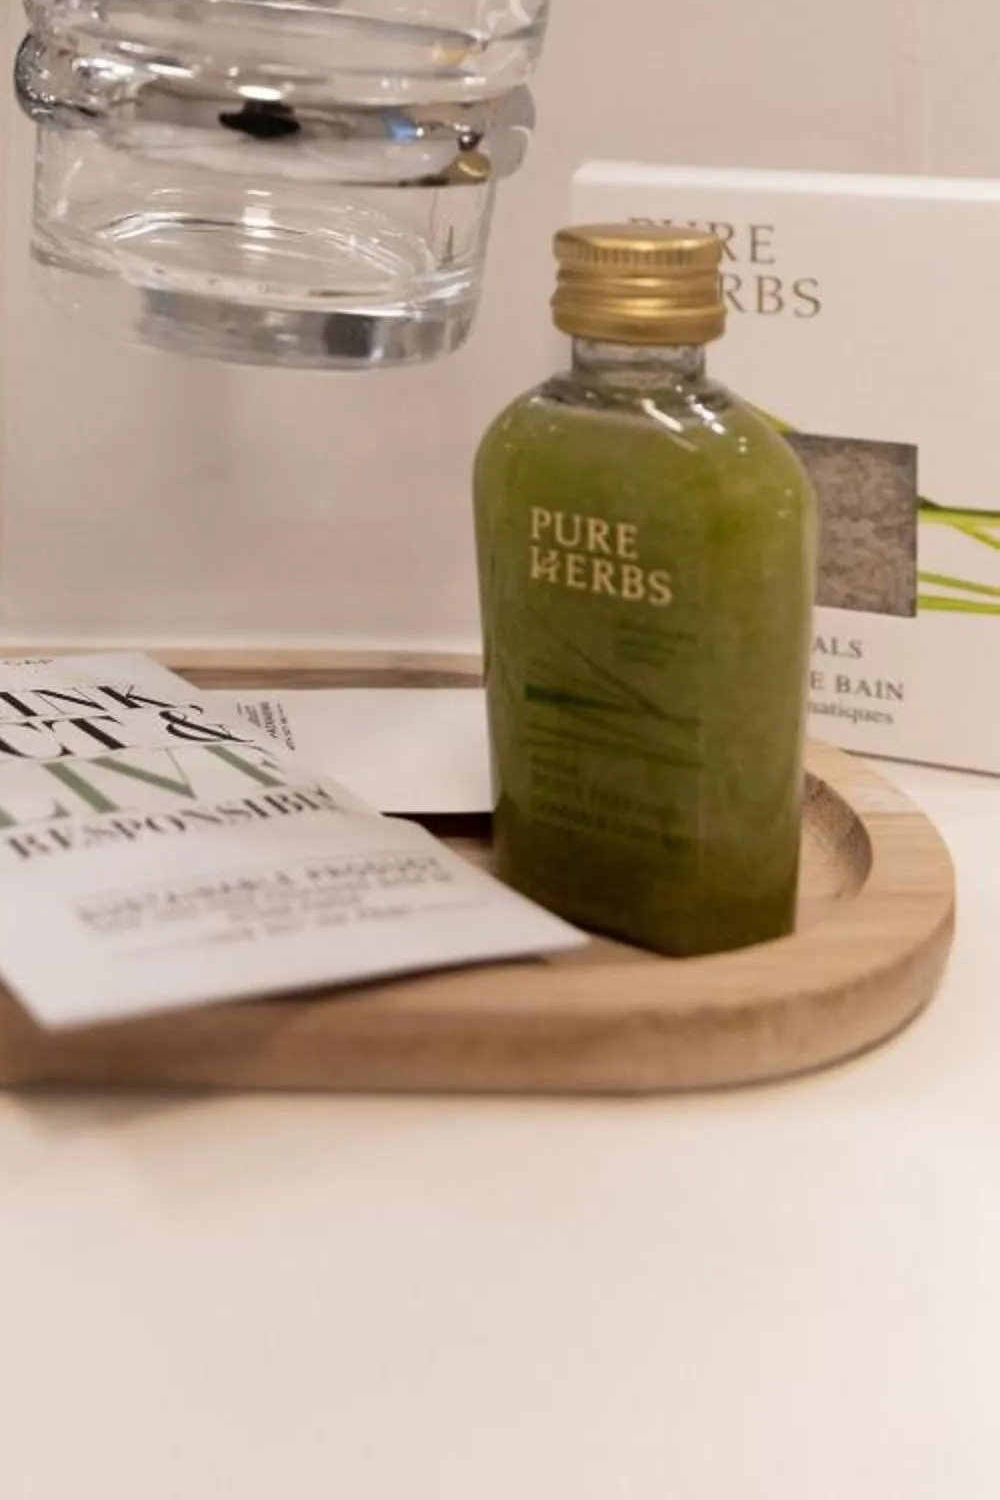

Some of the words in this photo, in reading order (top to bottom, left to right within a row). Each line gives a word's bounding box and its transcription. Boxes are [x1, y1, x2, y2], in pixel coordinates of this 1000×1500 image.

[718, 272, 822, 319] RBS
[529, 506, 639, 560] PURE
[529, 546, 674, 607] HERBS
[812, 636, 863, 659] ALS
[809, 671, 825, 691] E
[836, 675, 904, 701] BAIN
[159, 709, 254, 743] &
